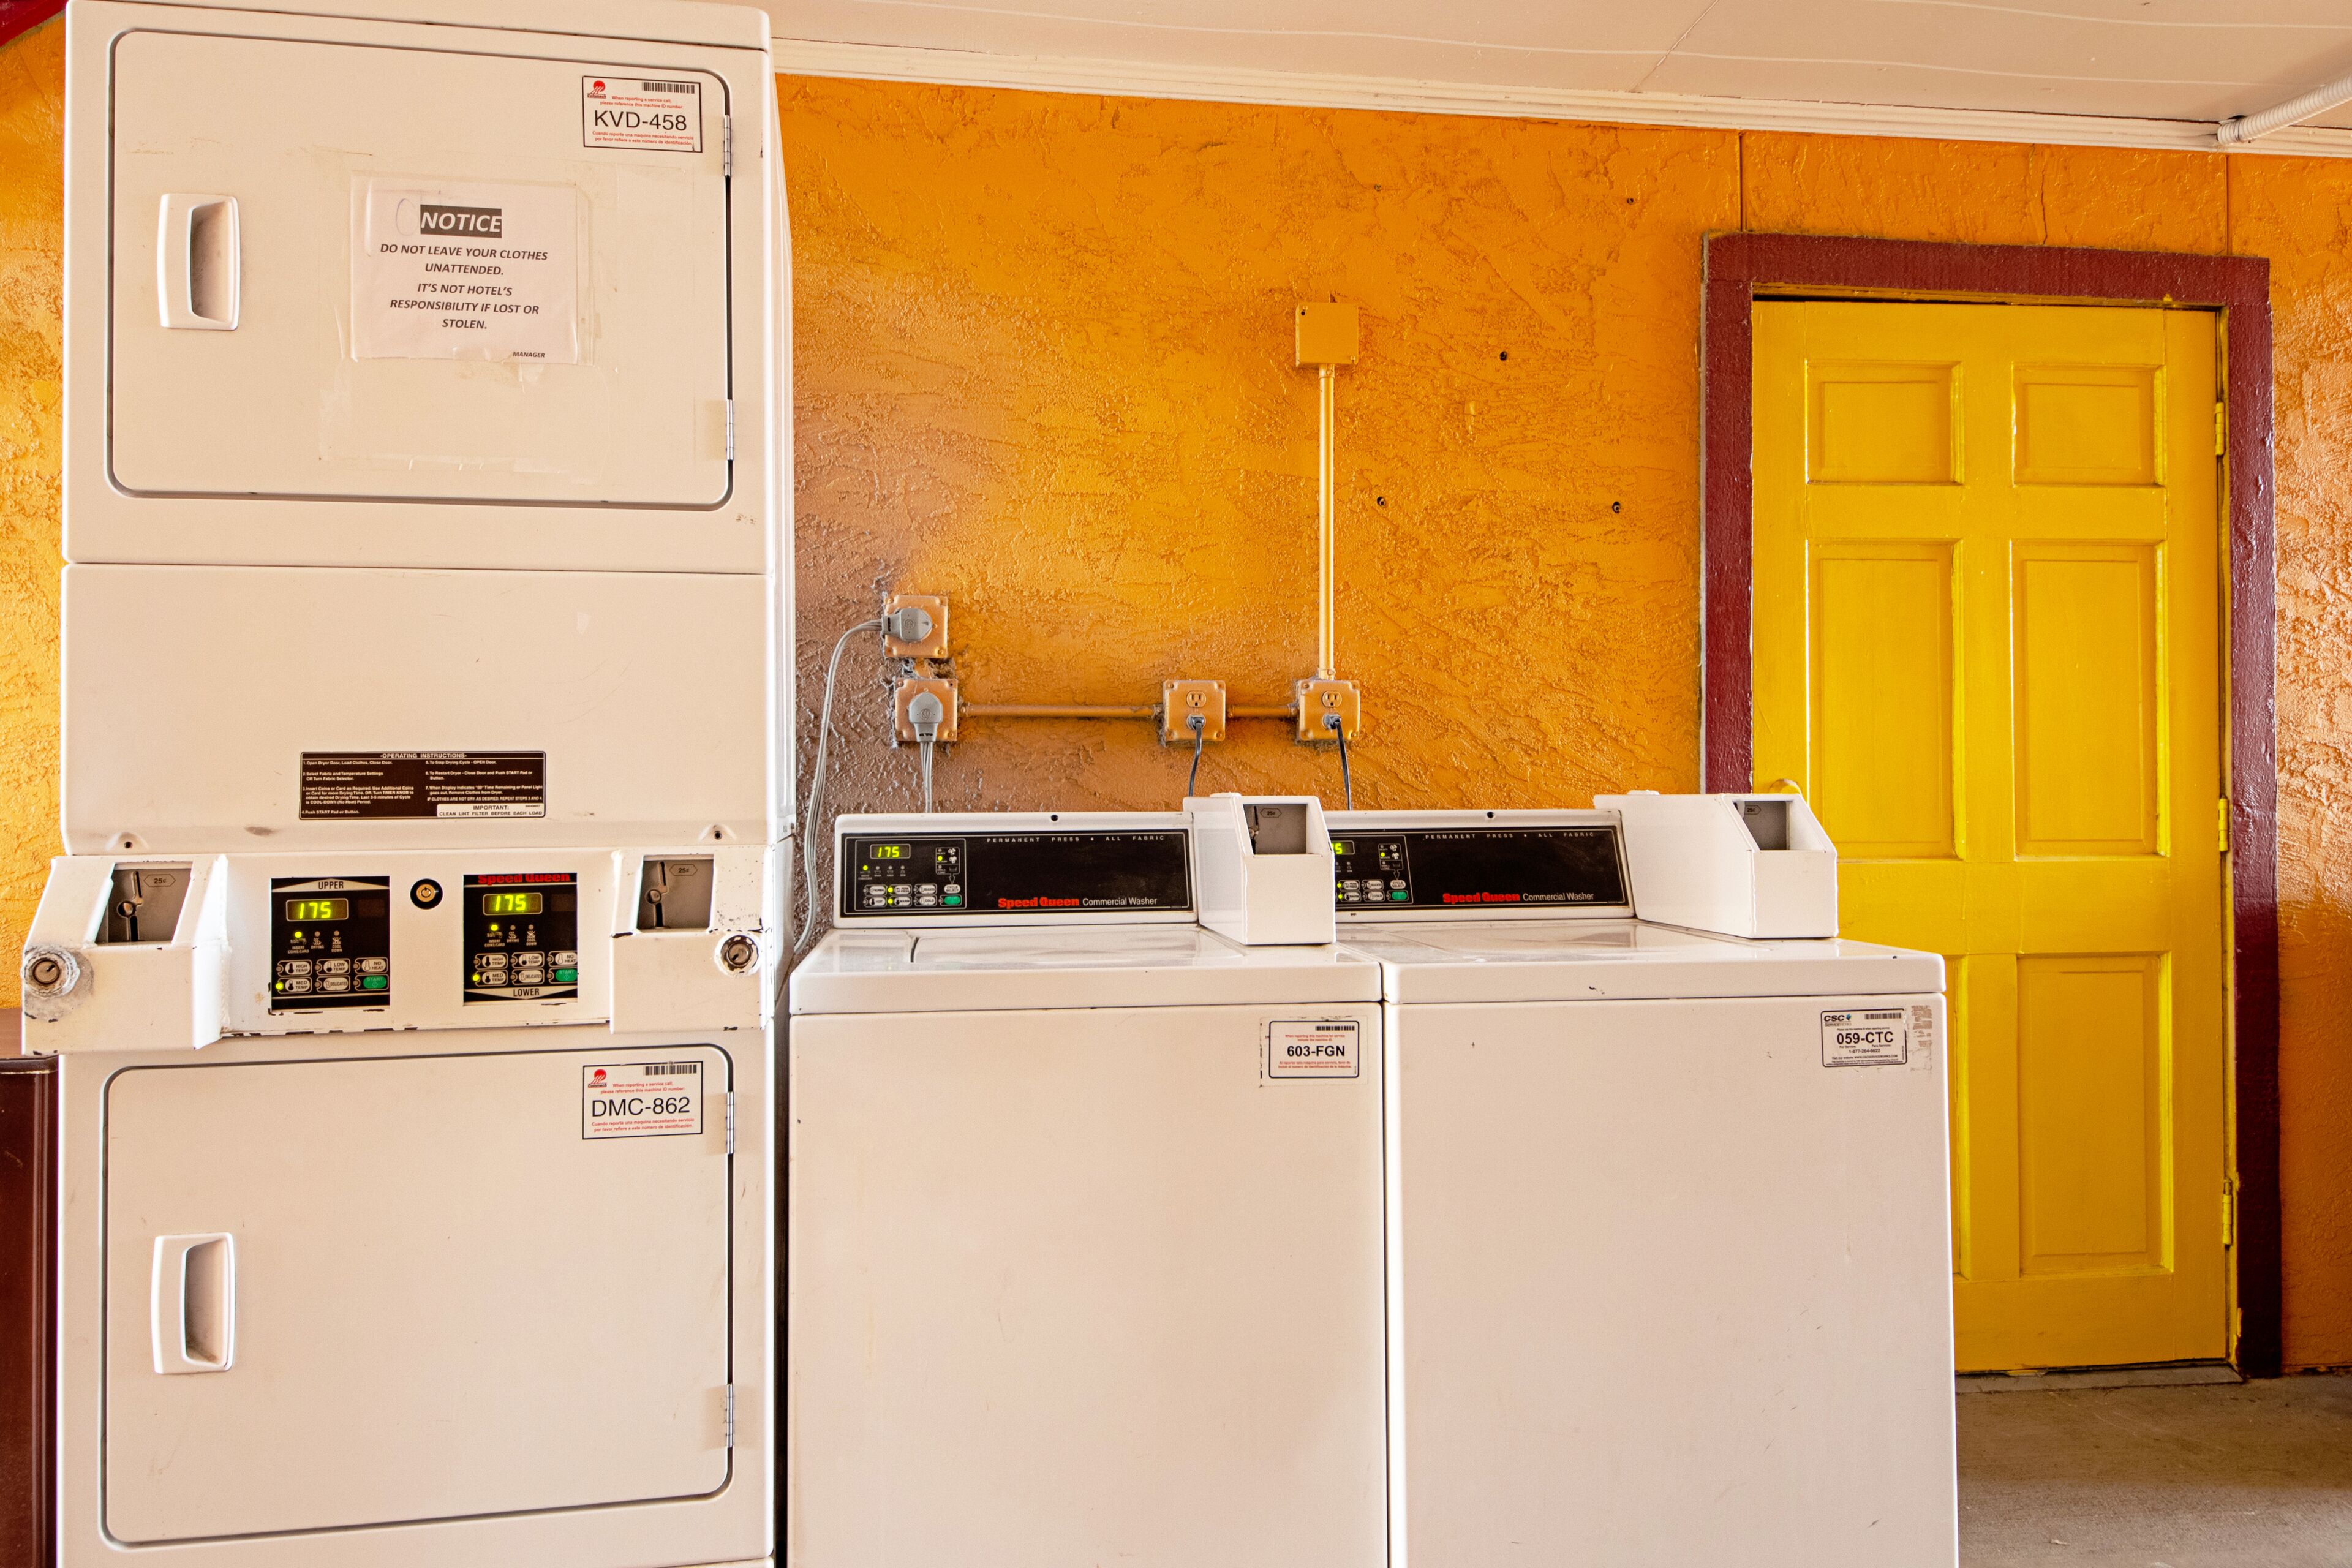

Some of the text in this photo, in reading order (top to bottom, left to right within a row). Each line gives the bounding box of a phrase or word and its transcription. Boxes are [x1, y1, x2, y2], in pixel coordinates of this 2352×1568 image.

[595, 110, 687, 131] KVD-458
[421, 211, 502, 232] NOTICE
[380, 244, 548, 261] DO NOT LEAVE YOUR CLOTHES
[425, 263, 504, 276] UNATTENDED.
[417, 284, 513, 296] IT'S NOT HOTEL'S
[390, 300, 539, 315] RESPONSIBILITY IF LOST OR
[442, 318, 488, 330] STOLEN.
[878, 846, 900, 858] 175
[478, 873, 570, 886] Speed Queen
[495, 895, 526, 911] 175
[998, 897, 1038, 910] Speed
[1039, 897, 1079, 907] Queen
[1082, 898, 1127, 907] Commercial
[1442, 893, 1480, 905] Speed
[1482, 892, 1520, 902] Queen
[1523, 893, 1565, 902] Commercial
[299, 902, 331, 919] 175
[1837, 1031, 1893, 1044] 059-CTC
[1287, 1045, 1345, 1057] 603-FGN
[592, 1096, 690, 1117] DMC-862
